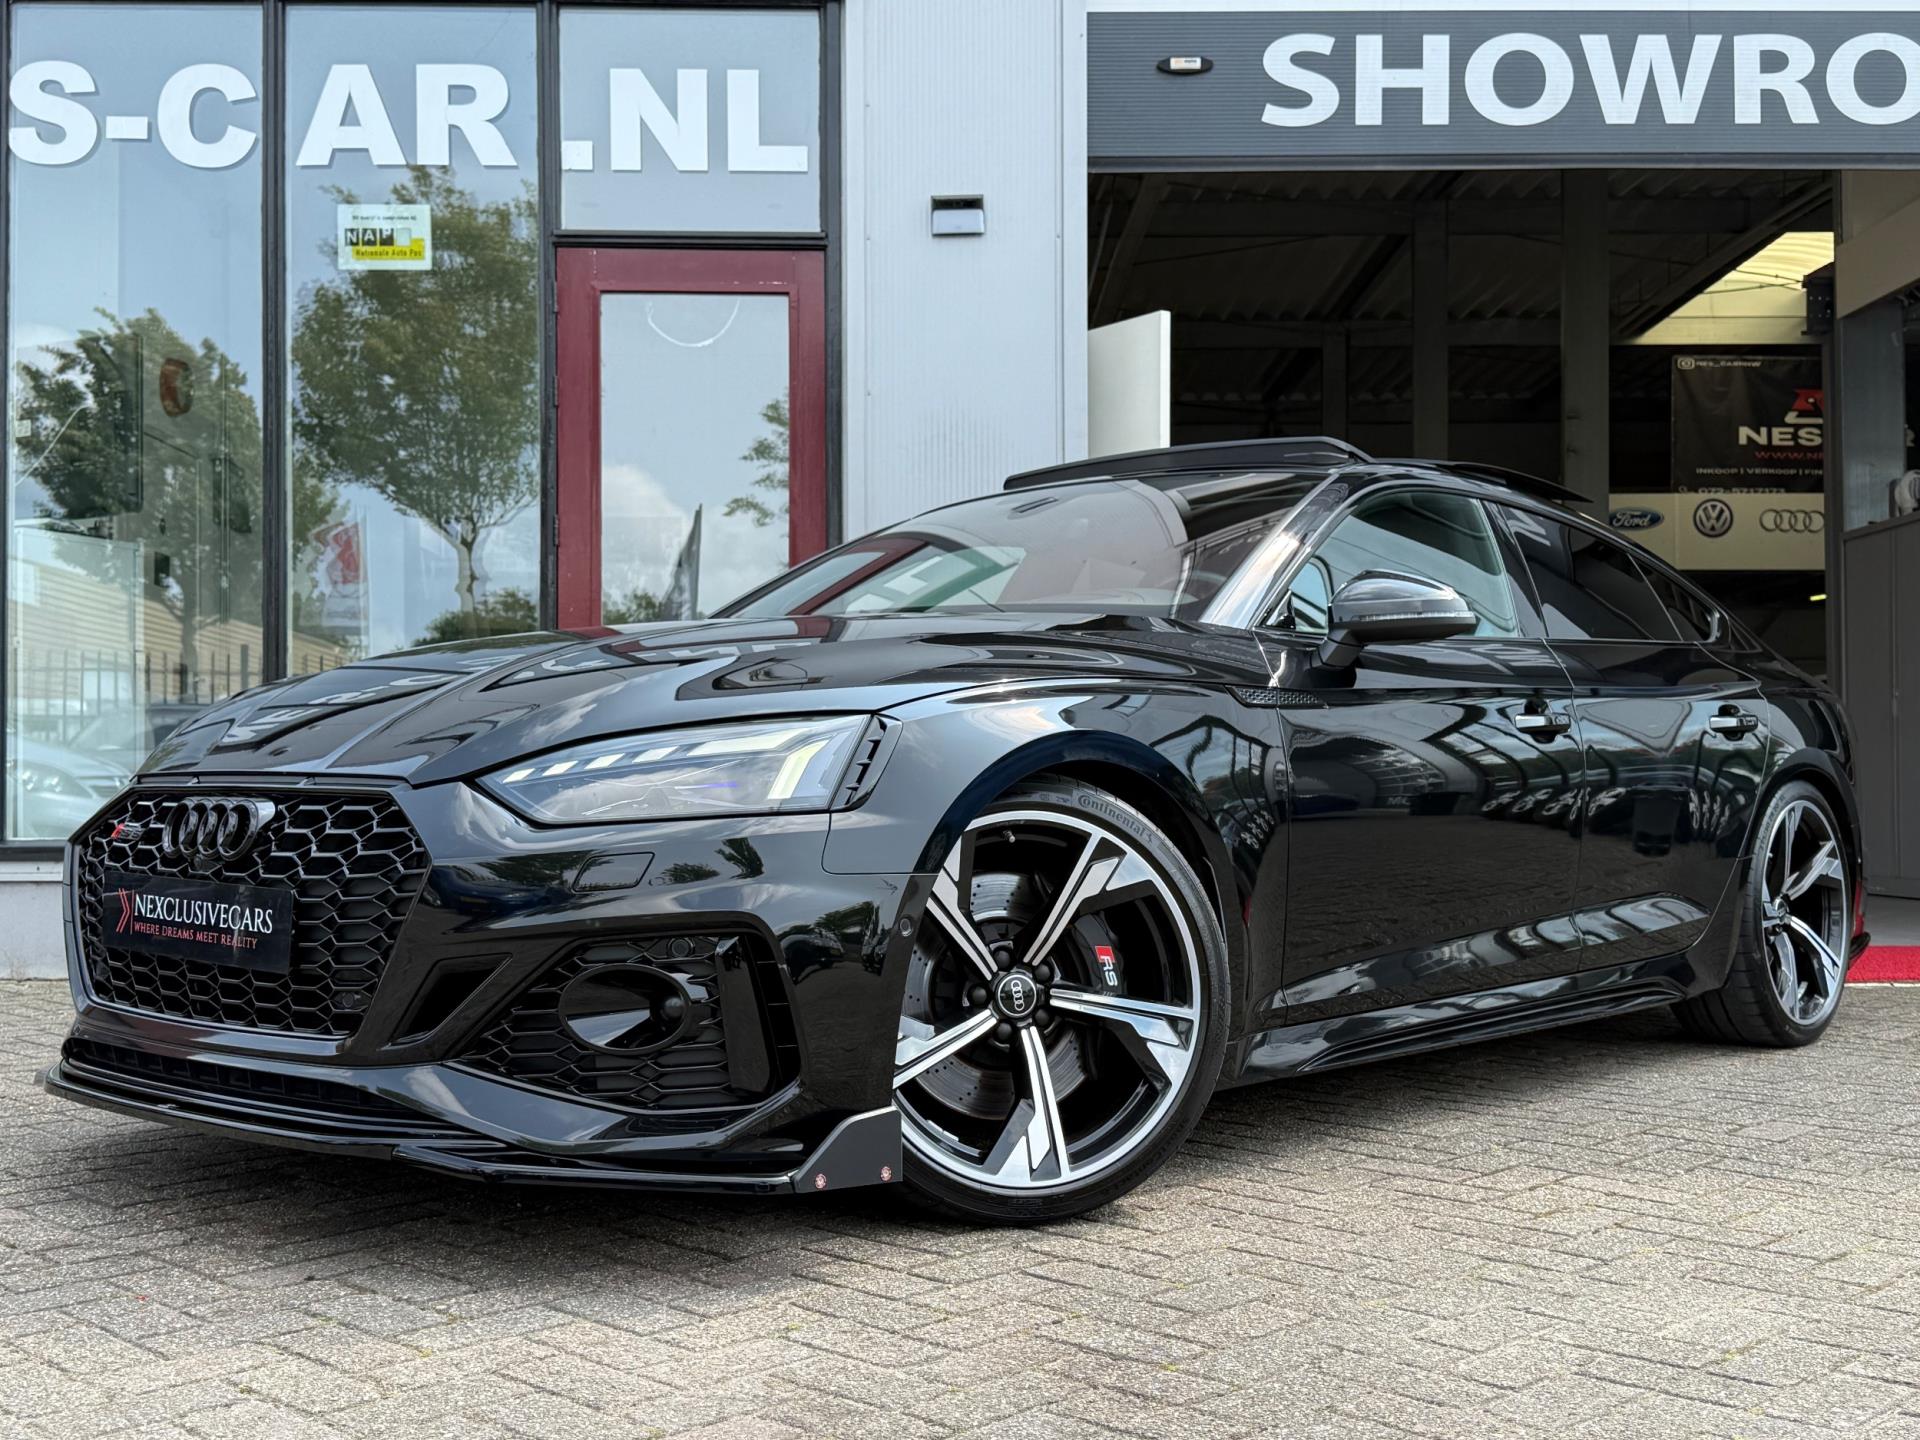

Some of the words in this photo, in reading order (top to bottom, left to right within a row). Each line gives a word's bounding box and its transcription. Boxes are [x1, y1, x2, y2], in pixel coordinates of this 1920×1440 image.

[1260, 33, 1920, 128] SHOWRO
[1738, 426, 1823, 446] NES
[1612, 511, 1651, 527] Ford
[1077, 794, 1147, 838] Continental
[133, 893, 273, 934] NEXCLUSIVECARS
[134, 921, 160, 936] WHERE
[162, 926, 194, 941] DREAMS
[196, 931, 219, 944] MEET
[221, 934, 258, 949] REALITY
[1100, 953, 1118, 988] RS
